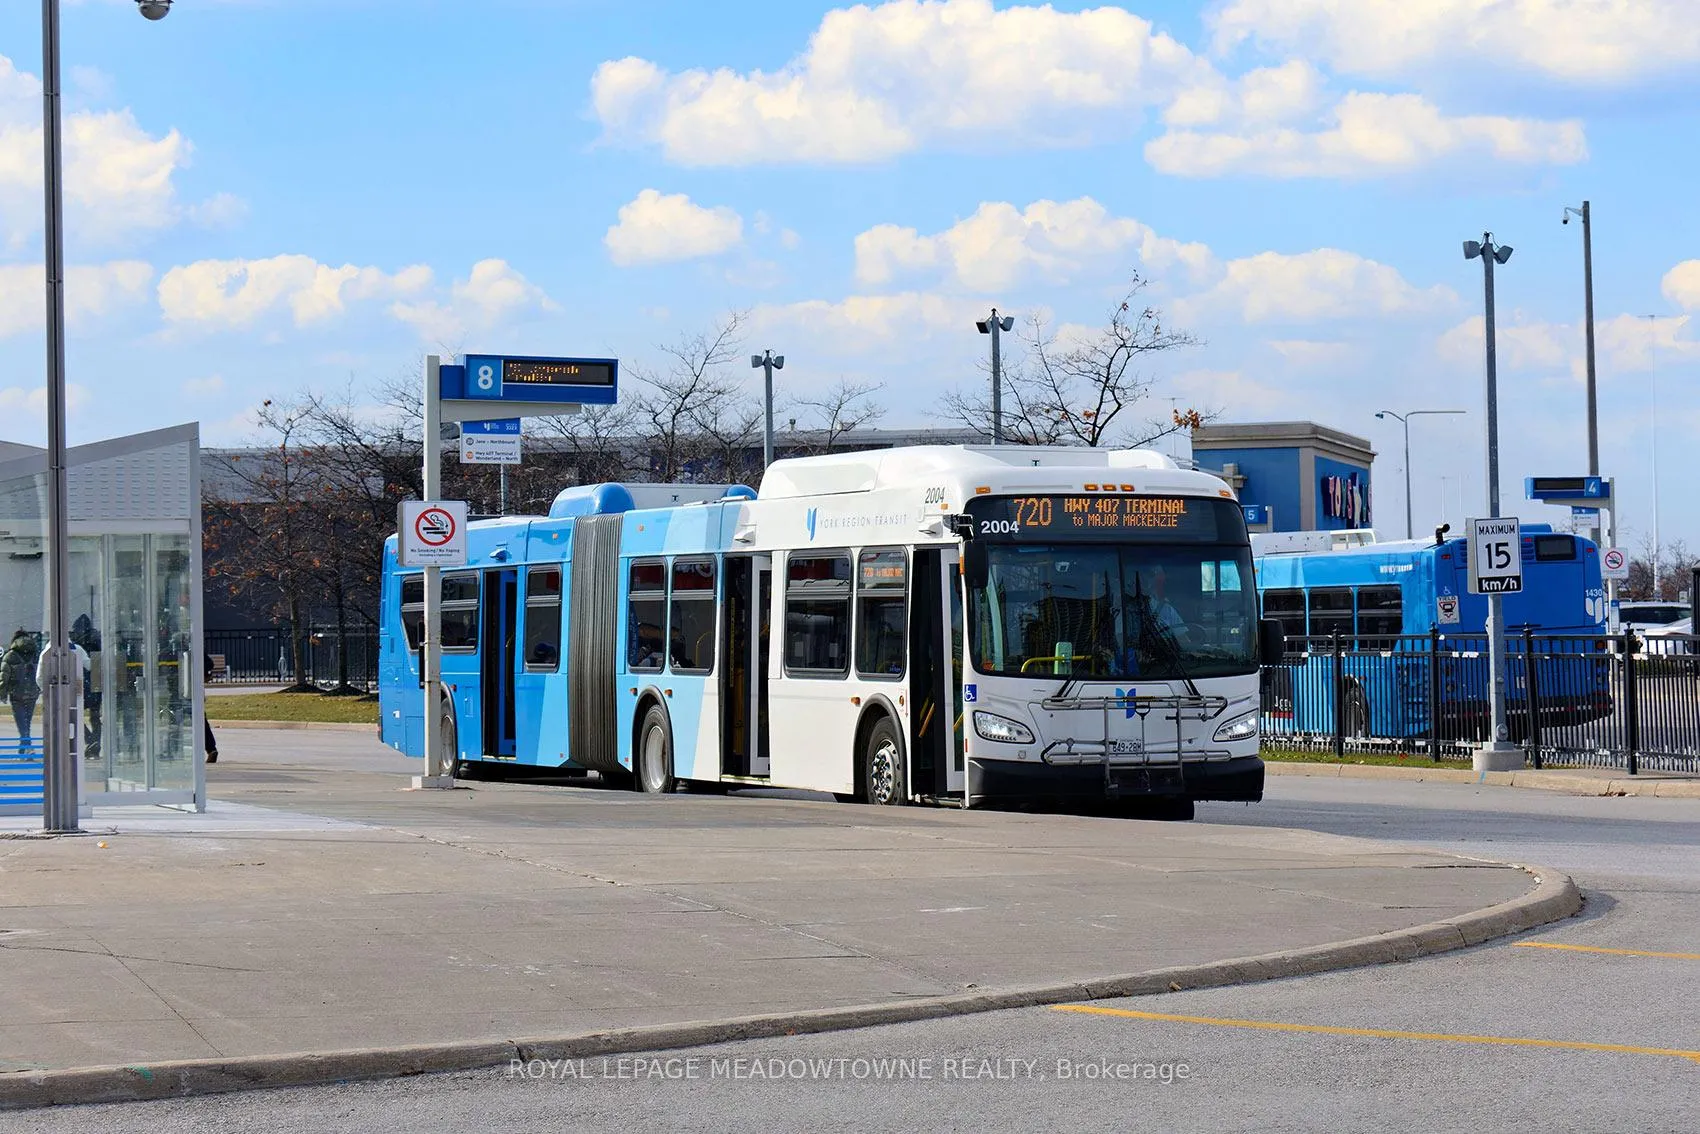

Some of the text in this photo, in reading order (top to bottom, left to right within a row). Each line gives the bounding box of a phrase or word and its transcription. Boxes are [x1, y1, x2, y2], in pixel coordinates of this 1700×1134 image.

[478, 365, 493, 390] 8
[1588, 483, 1596, 493] 4
[925, 487, 945, 504] 2004
[1014, 498, 1187, 526] 720 HWY 407 TERMINAL
[1248, 510, 1255, 520] 5
[842, 516, 871, 528] REGION
[875, 514, 907, 526] TRANSIT
[981, 520, 1019, 534] 2004
[1073, 514, 1178, 527] to MAJOR MACKENZIE
[1479, 525, 1515, 535] MAXIMUM
[1485, 542, 1511, 569] 15
[1482, 578, 1517, 591] km/h
[1585, 589, 1602, 597] 1430
